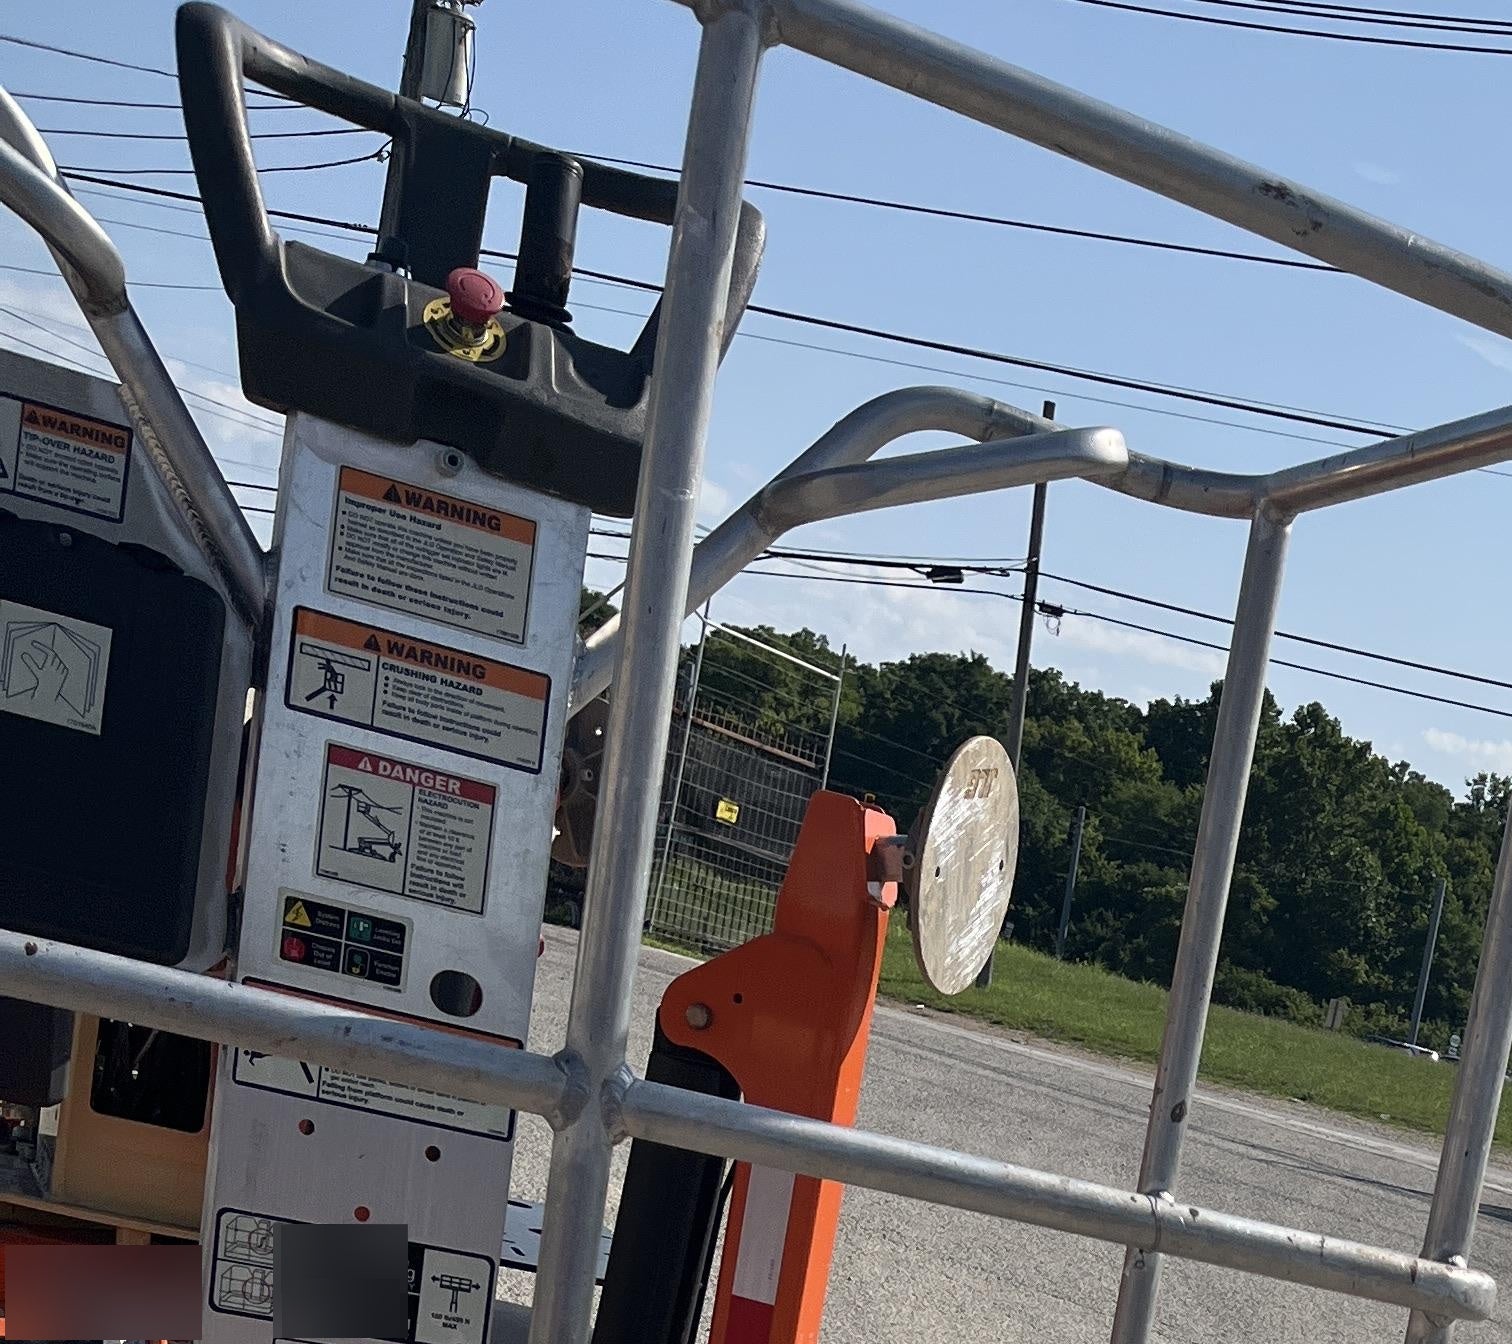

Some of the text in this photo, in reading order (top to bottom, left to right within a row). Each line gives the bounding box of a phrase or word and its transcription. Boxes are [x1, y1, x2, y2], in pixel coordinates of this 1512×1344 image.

[41, 414, 126, 448] WARNING
[73, 444, 114, 463] HAZARD
[344, 496, 440, 530] Improper Use Hazard
[404, 489, 501, 532] WARNING
[481, 605, 503, 618] could
[387, 639, 487, 680] WARNING
[381, 661, 436, 683] CRUSHING
[440, 677, 482, 696] HAZARD
[378, 760, 461, 795] DANGER
[418, 788, 479, 809] ELECTROCUTION
[418, 796, 448, 809] HAZARD
